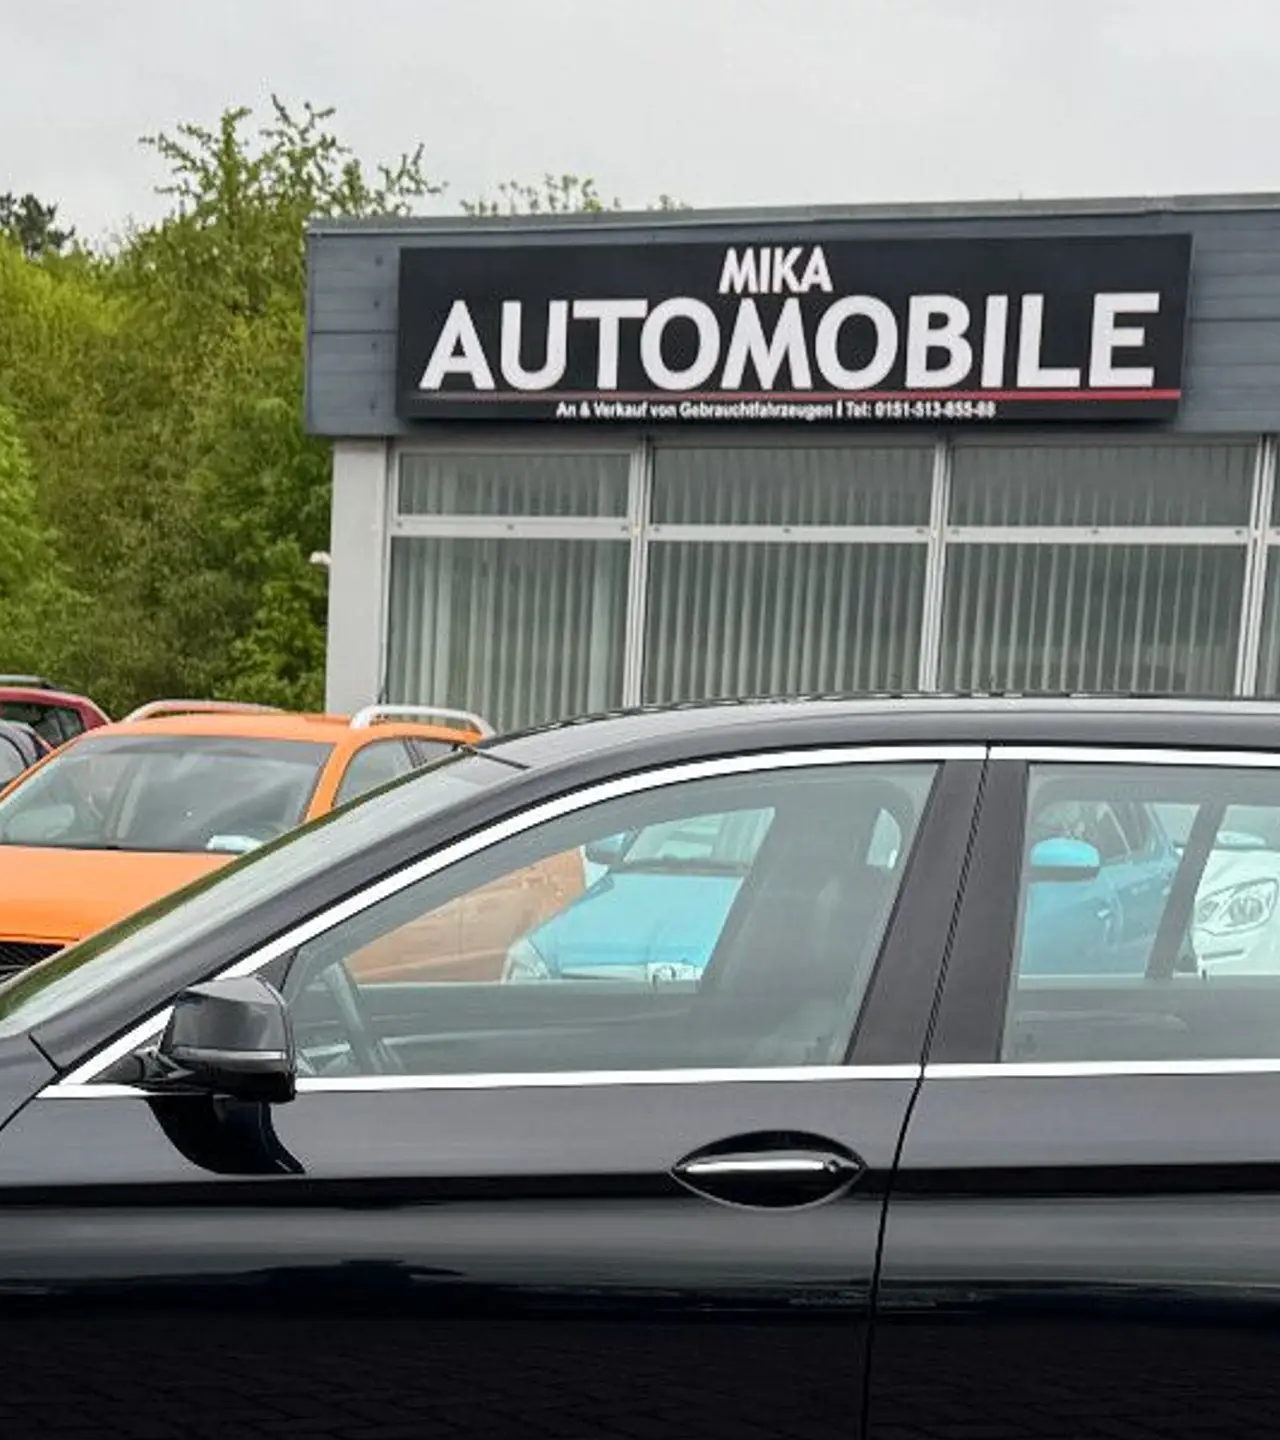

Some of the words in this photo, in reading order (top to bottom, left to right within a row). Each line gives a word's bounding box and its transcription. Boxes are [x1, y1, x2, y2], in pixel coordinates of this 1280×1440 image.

[718, 245, 834, 294] MIKA
[419, 292, 1160, 390] AUTOMOBILE
[556, 401, 576, 418] An
[579, 401, 591, 418] &
[593, 401, 648, 418] Verkauf
[650, 404, 677, 418] von
[679, 401, 833, 420] Gebrauchtfahrzeugen
